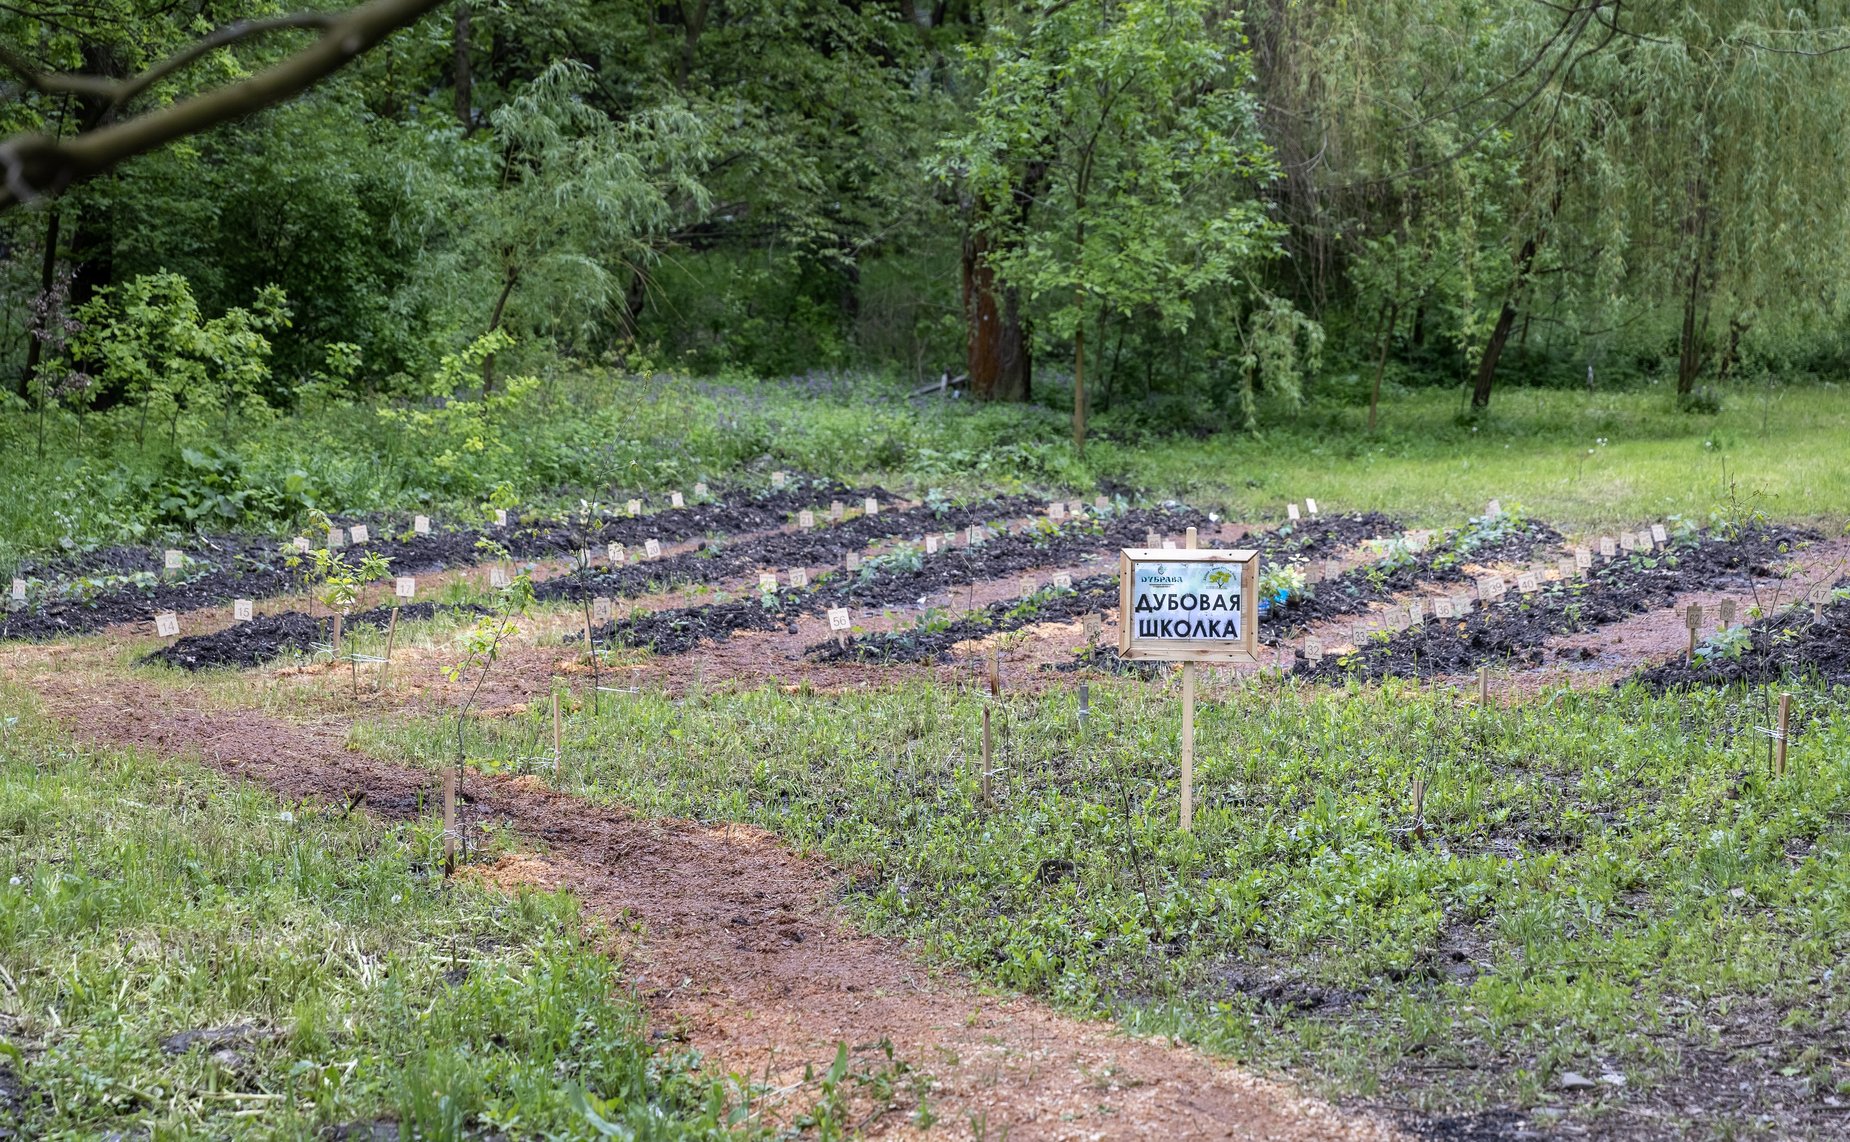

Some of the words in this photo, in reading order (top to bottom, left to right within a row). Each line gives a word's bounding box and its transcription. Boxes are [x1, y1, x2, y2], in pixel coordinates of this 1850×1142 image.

[793, 575, 804, 584] 27
[1521, 579, 1534, 589] 40
[1489, 582, 1503, 594] 39
[1812, 590, 1828, 600] 47
[1135, 593, 1240, 613] ДУБОВАЯ
[239, 608, 250, 618] 15
[597, 605, 608, 616] 24
[1438, 605, 1450, 615] 36
[1723, 606, 1734, 617] 68
[833, 615, 847, 627] 56
[1689, 614, 1700, 625] 62
[163, 621, 175, 632] 14
[1086, 621, 1099, 633] 66
[1139, 619, 1238, 638] ШКОЛКА
[1354, 631, 1366, 642] 33
[1307, 645, 1320, 656] 32
